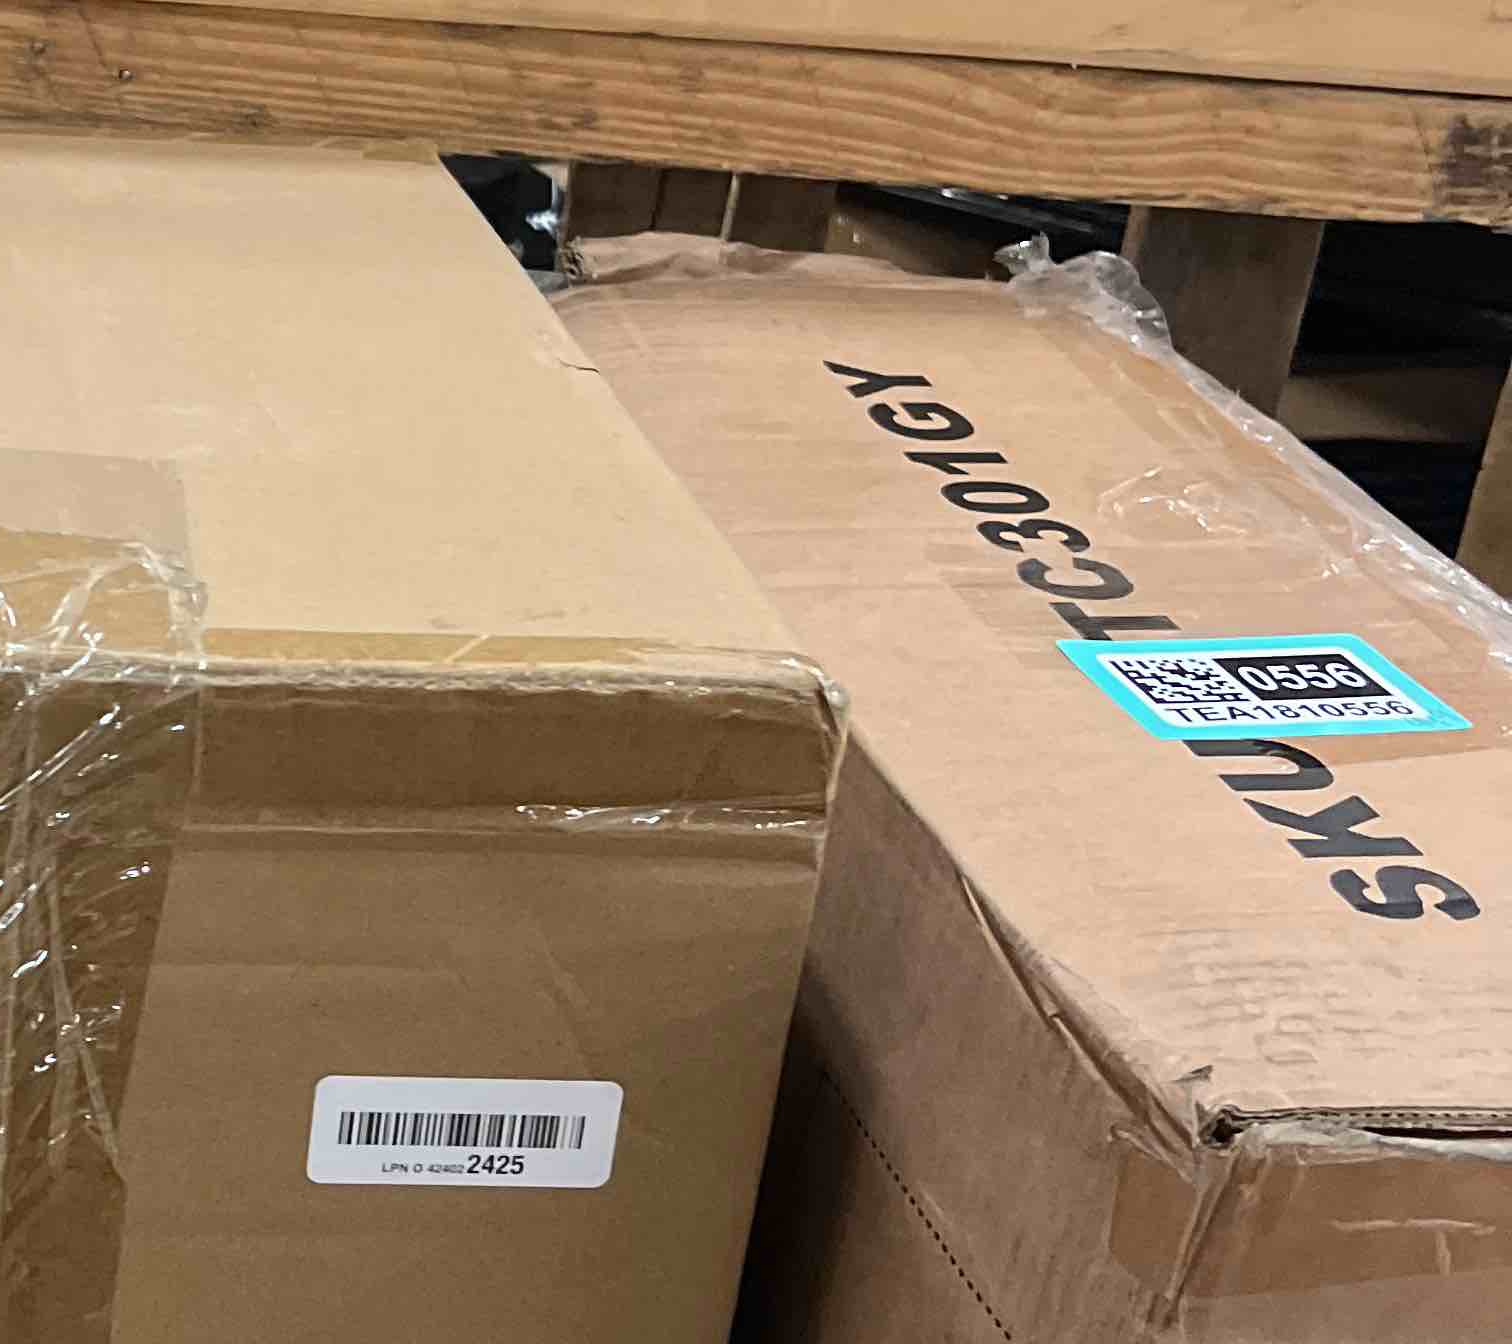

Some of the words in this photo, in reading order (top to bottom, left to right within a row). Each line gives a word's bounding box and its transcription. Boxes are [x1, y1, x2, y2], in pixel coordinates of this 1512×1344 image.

[823, 359, 1181, 641] TC301GY
[1237, 661, 1370, 694] 0556
[1165, 698, 1414, 724] TEA1810556
[381, 1163, 409, 1173] LPN
[466, 1154, 525, 1175] 2425
